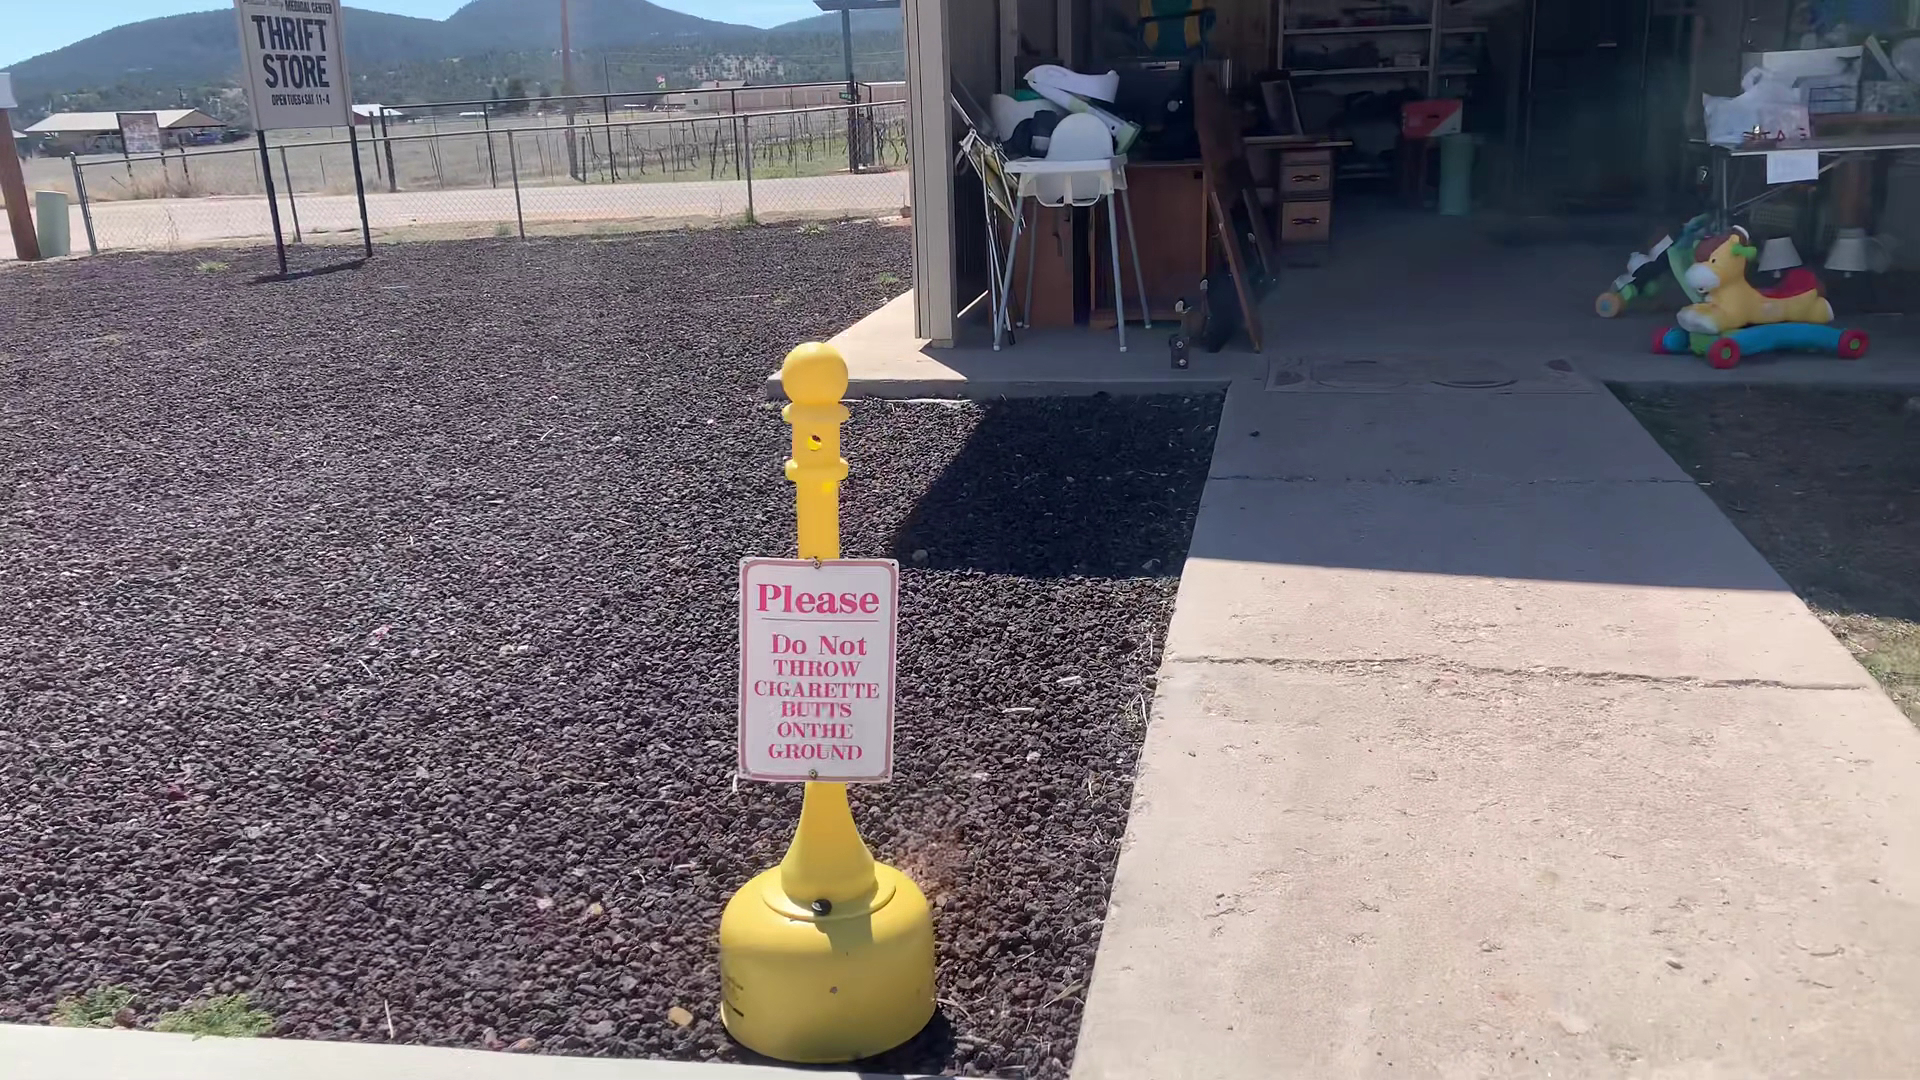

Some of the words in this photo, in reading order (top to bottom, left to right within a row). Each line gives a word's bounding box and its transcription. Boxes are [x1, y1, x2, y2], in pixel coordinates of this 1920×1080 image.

[285, 0, 311, 13] MEDICAL
[312, 2, 333, 14] CENTER
[251, 15, 327, 52] THRIFT
[262, 53, 330, 89] STORE
[271, 93, 287, 106] OPEN
[756, 583, 880, 614] Please
[771, 633, 807, 655] Do
[818, 635, 868, 656] Not
[773, 659, 862, 677] THROW
[754, 680, 880, 699] CIGARETTE
[781, 701, 852, 719] BUTTS
[768, 743, 863, 761] GROUND
